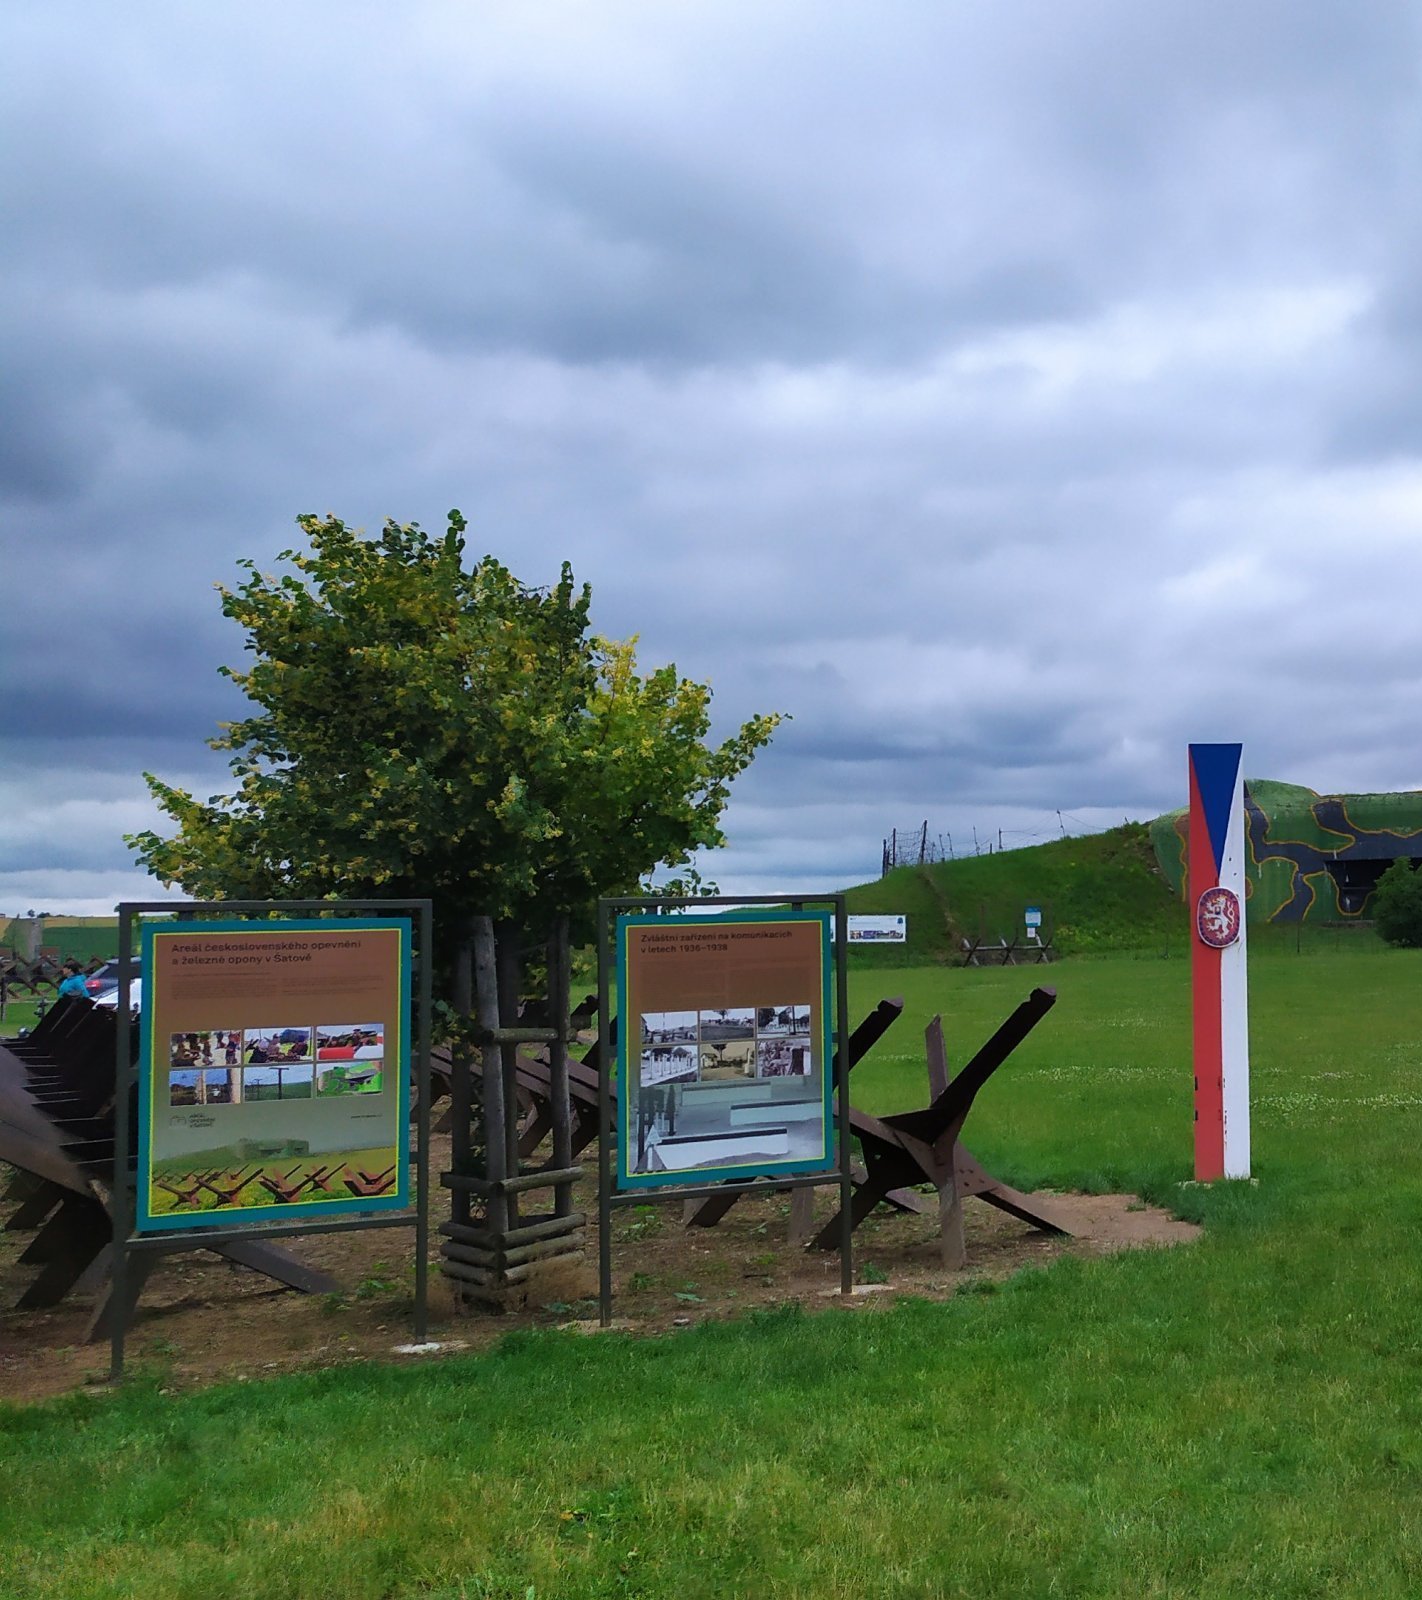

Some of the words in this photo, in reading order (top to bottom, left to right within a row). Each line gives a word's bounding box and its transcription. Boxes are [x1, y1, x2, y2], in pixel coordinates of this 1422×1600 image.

[171, 943, 202, 953] Areál
[204, 941, 308, 952] československého
[311, 940, 361, 951] opevnění
[648, 944, 677, 953] letech
[228, 955, 263, 965] opony
